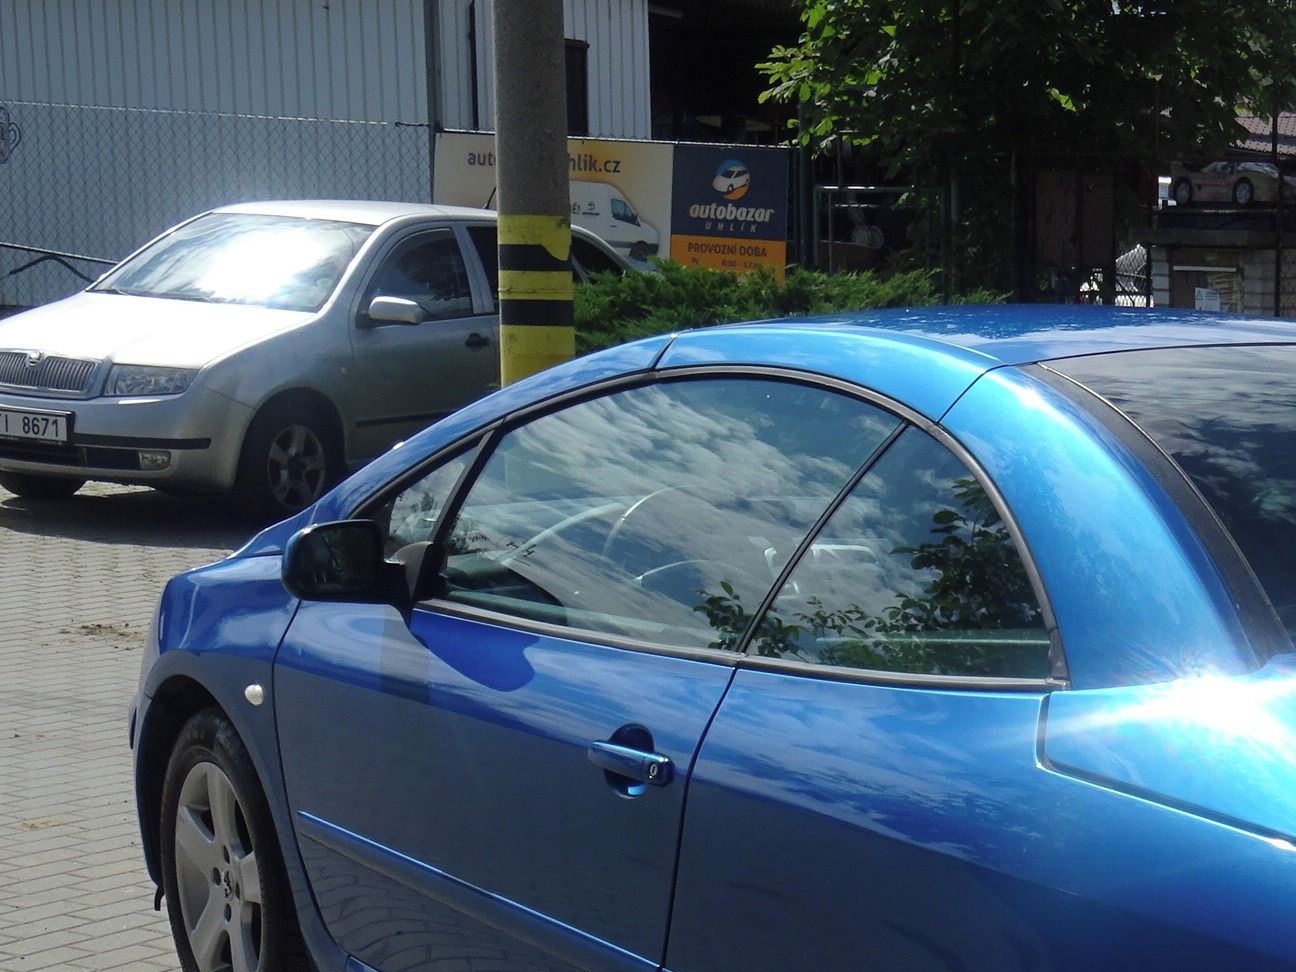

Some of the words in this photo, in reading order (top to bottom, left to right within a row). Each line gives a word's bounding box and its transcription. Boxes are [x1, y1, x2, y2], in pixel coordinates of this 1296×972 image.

[689, 203, 775, 222] autobazar
[739, 245, 768, 258] DOBA
[22, 416, 59, 437] 8671
